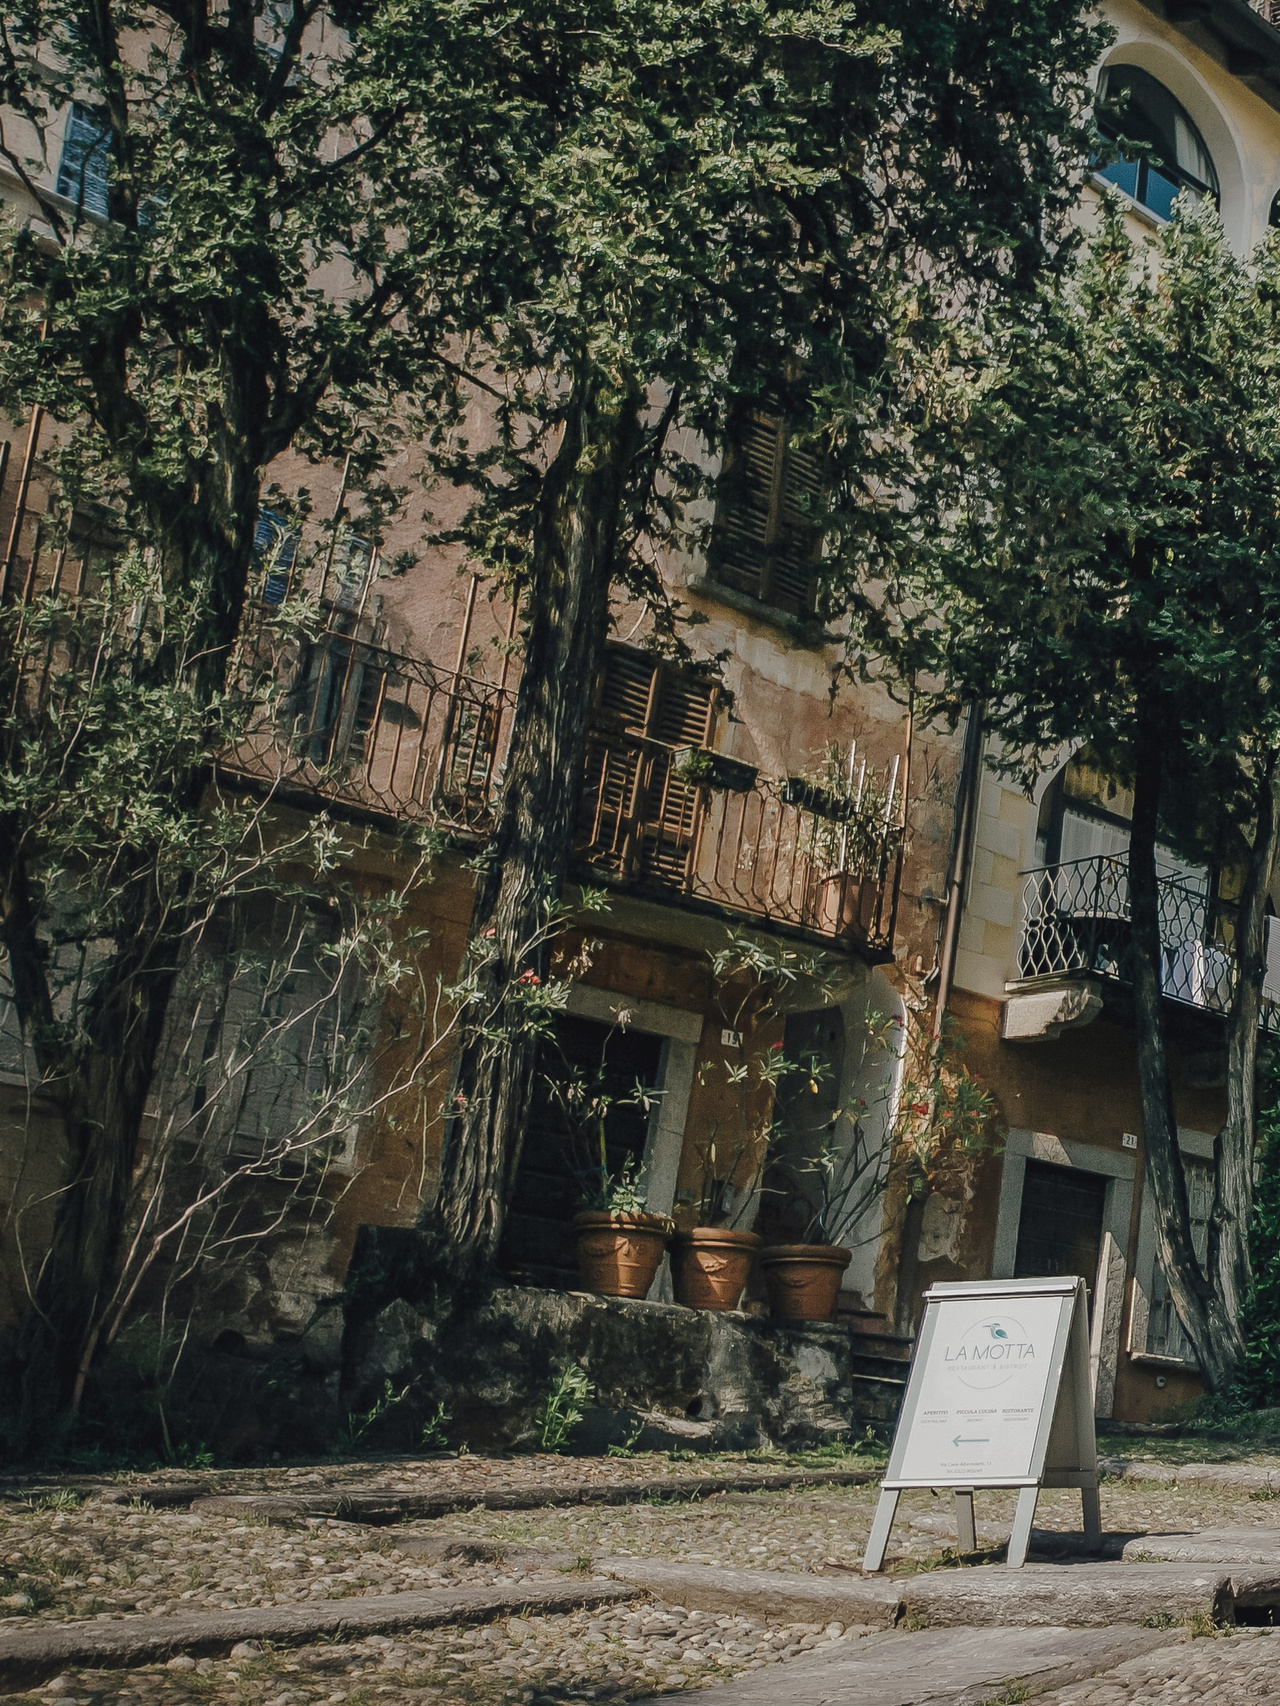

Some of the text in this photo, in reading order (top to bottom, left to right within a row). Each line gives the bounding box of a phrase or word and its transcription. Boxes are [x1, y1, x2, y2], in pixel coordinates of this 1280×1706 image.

[1125, 1135, 1134, 1145] 21
[945, 1343, 1035, 1361] LA MOTTA
